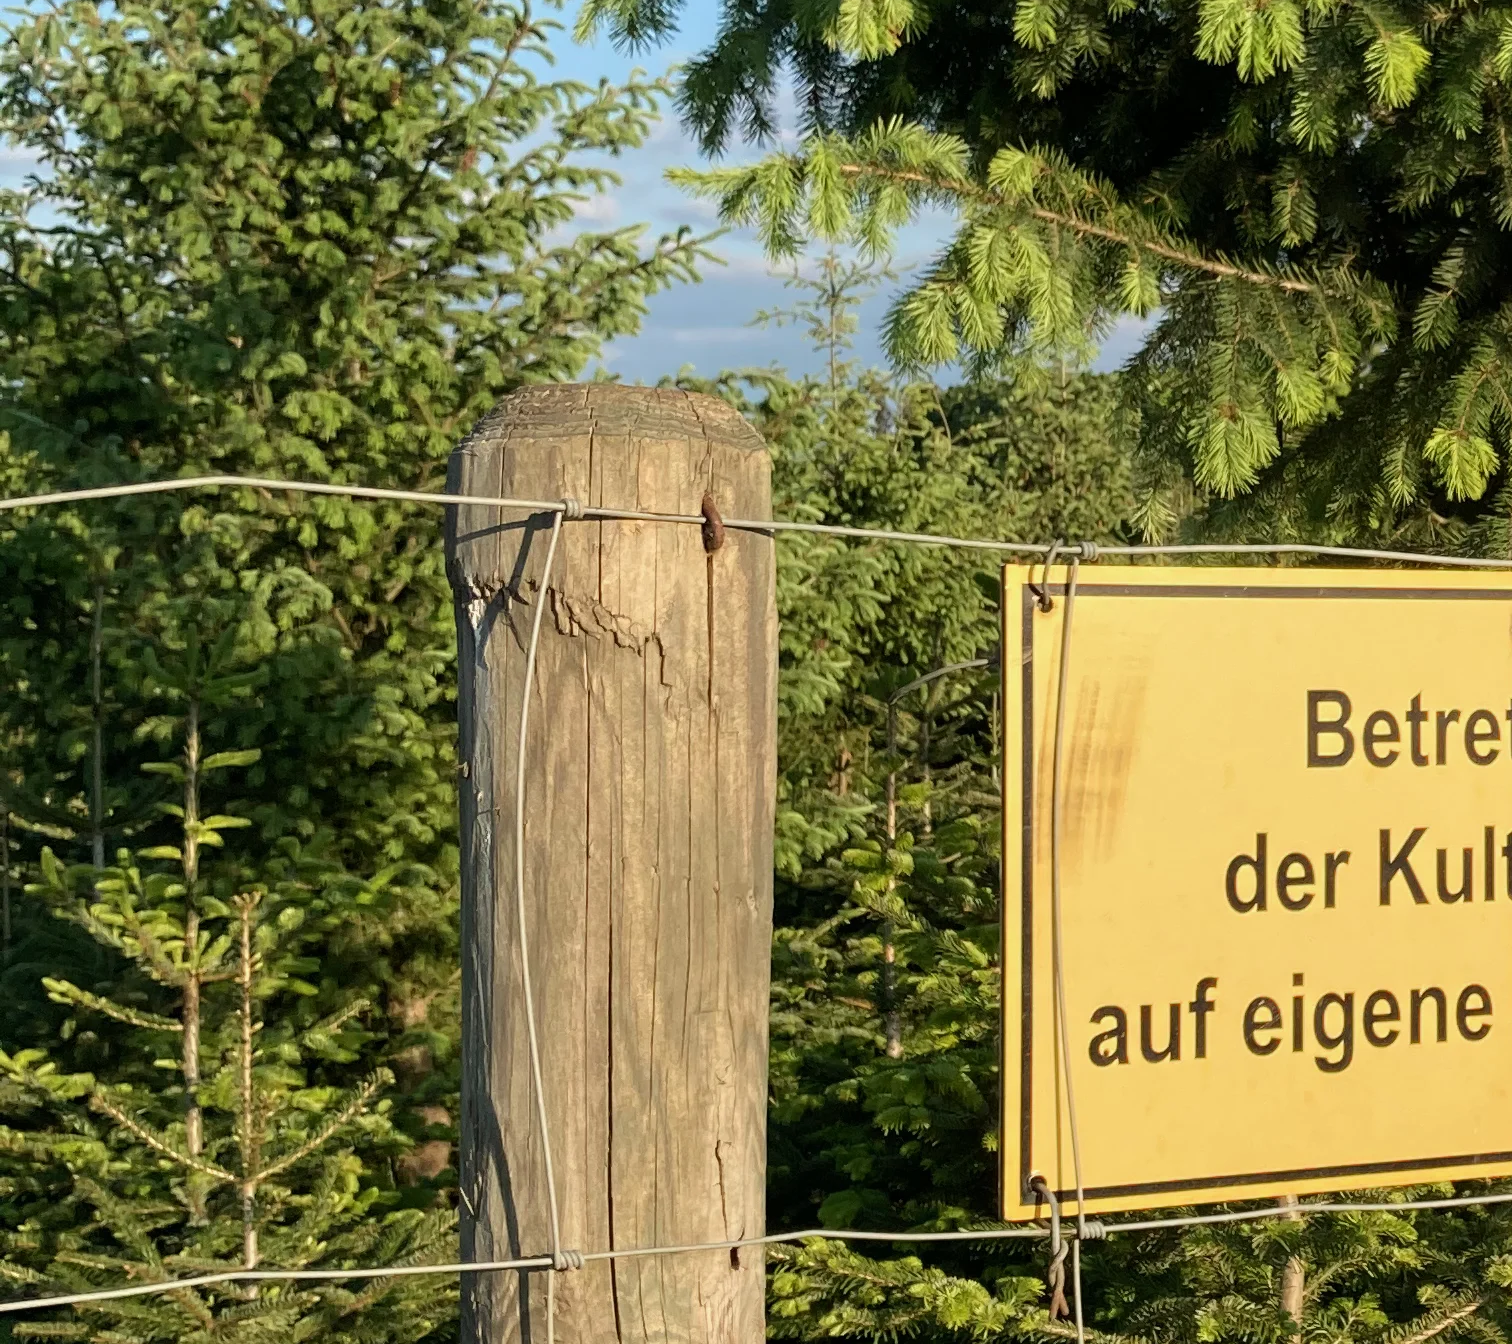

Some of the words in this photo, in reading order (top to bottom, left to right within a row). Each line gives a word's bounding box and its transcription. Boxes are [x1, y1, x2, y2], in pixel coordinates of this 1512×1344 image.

[1225, 832, 1351, 913] der
[1087, 977, 1218, 1068] auf
[1242, 973, 1493, 1074] eigene
